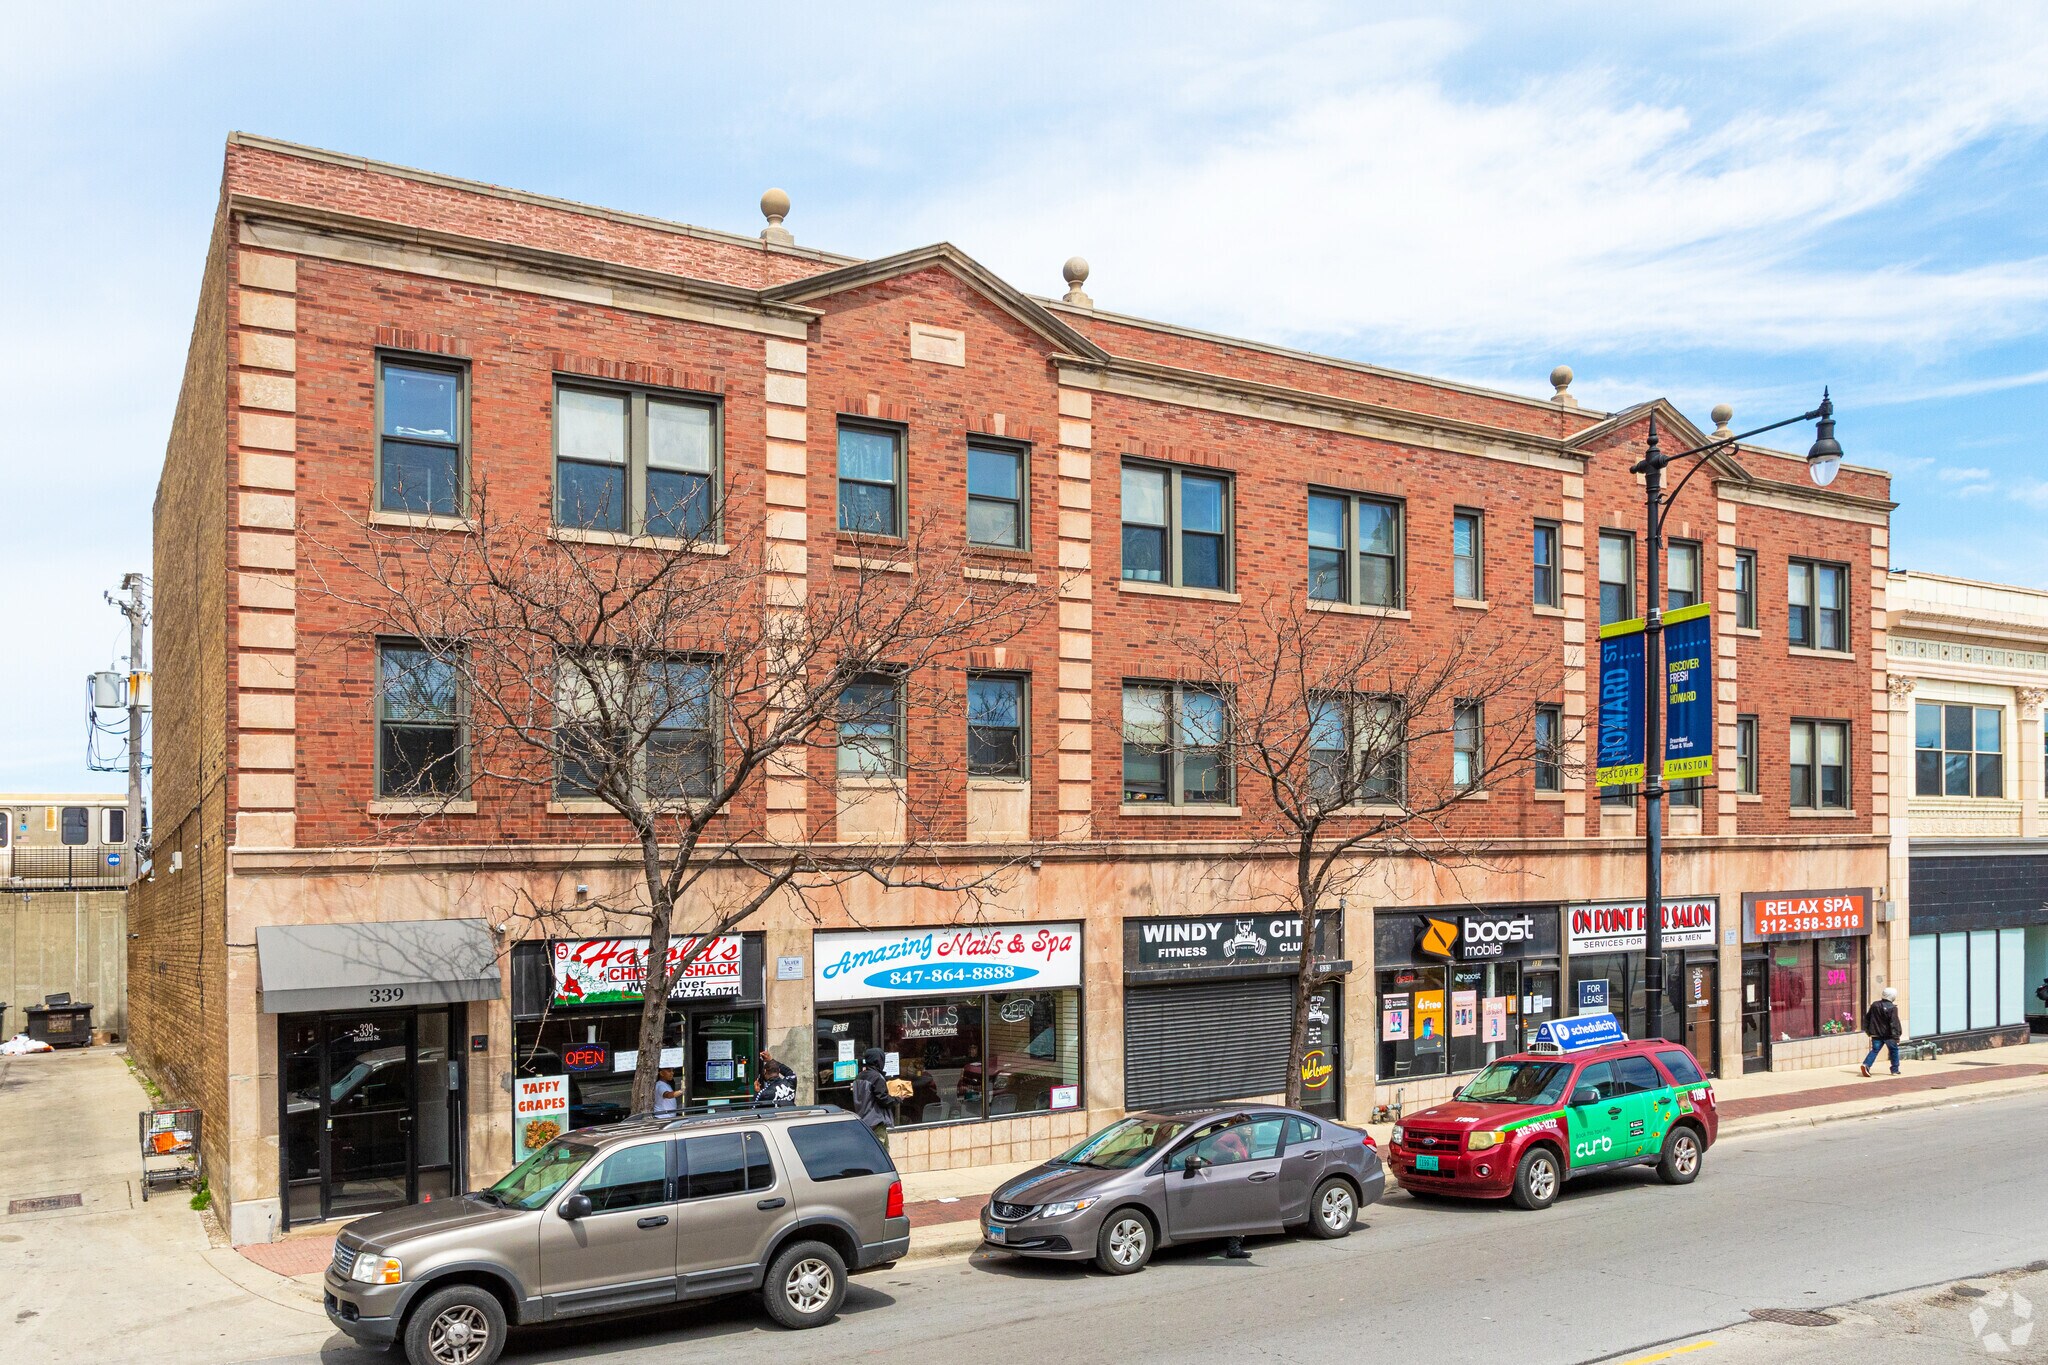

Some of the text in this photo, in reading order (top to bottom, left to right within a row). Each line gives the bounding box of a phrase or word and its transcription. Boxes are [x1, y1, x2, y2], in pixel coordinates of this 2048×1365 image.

[1669, 658, 1700, 673] DISCOVER
[1669, 671, 1689, 684] FRESH
[1669, 683, 1678, 694] ON
[1601, 643, 1629, 763] HOWARD ST
[1669, 690, 1697, 705] HOWARD
[1600, 766, 1639, 780] DISCOVER
[1668, 759, 1708, 773] EVANSTON
[1765, 898, 1853, 916] RELAX SPA
[1572, 904, 1711, 934] ON POINT HR SALON
[1760, 915, 1859, 933] 312-358-3818
[1143, 918, 1321, 943] WINDY CIT
[1464, 914, 1534, 943] boost
[1584, 938, 1624, 949] SERVICES
[1625, 937, 1643, 946] FOR
[1678, 934, 1683, 942] &
[1685, 933, 1702, 942] MEN
[557, 945, 567, 958] 5
[822, 929, 1073, 979] Amazing Nails & Spa
[1158, 942, 1303, 958] FITNESS CLU
[1465, 943, 1502, 957] mobile
[684, 962, 739, 977] SHACK
[889, 965, 1015, 985] 847-864-8888
[1395, 975, 1414, 984] OPEN
[1827, 969, 1847, 986] SPA
[369, 987, 404, 1004] 339
[670, 986, 740, 999] 47-733-0711
[1586, 984, 1601, 993] FOR
[1417, 997, 1425, 1010] 4
[1425, 1000, 1442, 1009] Free
[1486, 1001, 1503, 1010] Free
[1583, 995, 1604, 1005] LEASE
[904, 1005, 959, 1028] NAILS
[1001, 1003, 1034, 1019] OPEN
[712, 1014, 733, 1024] 337
[832, 1023, 849, 1033] 335
[1570, 1019, 1617, 1036] schedulicity
[565, 1050, 604, 1065] OPEN
[1301, 1058, 1334, 1080] Welcome
[522, 1080, 560, 1095] TAFFY
[1692, 1087, 1707, 1102] 1199
[518, 1096, 566, 1112] GRAPES
[1575, 1135, 1612, 1158] curb
